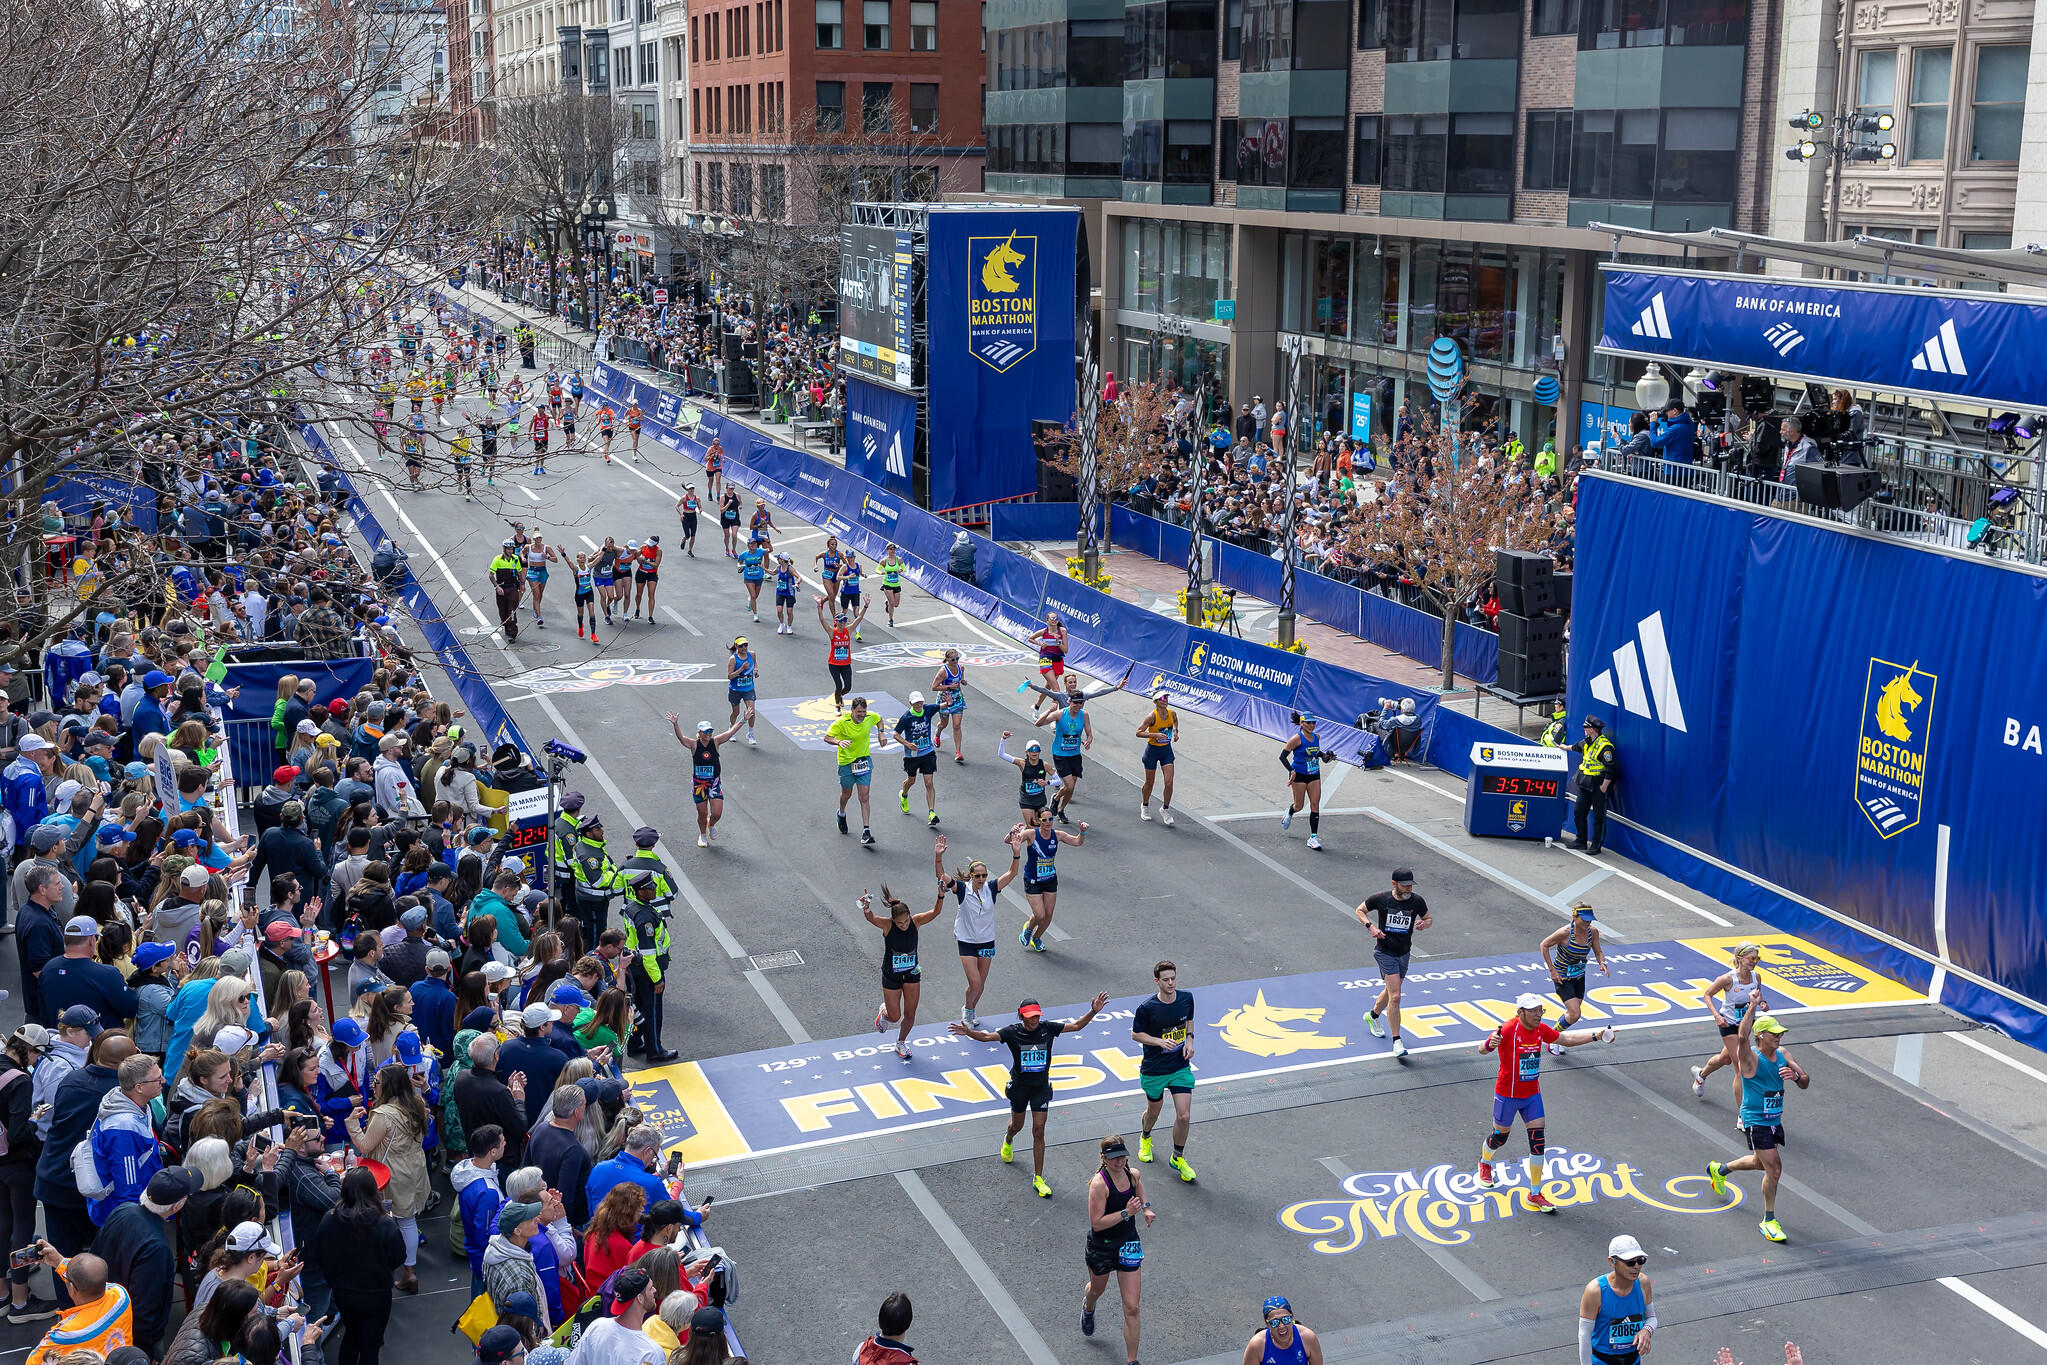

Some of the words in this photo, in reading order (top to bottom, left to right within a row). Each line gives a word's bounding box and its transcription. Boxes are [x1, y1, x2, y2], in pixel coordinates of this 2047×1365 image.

[972, 298, 1032, 313] BOSTON
[1736, 296, 1768, 310] BANK
[1769, 299, 1785, 312] OF
[1786, 301, 1840, 318] AMERICA
[972, 314, 1032, 326] MARATHON
[852, 410, 862, 424] BANK
[870, 418, 887, 432] AMERICA
[1045, 596, 1062, 610] BANK
[1067, 606, 1090, 624] AMERICA
[1208, 668, 1224, 679] BANK
[1224, 672, 1232, 681] OF
[1232, 675, 1263, 690] AMERICA
[1210, 652, 1244, 673] BOSTON
[1244, 664, 1294, 688] MARATHON
[1165, 679, 1190, 694] BOSTON
[1190, 685, 1224, 703] MARATHON
[1524, 752, 1562, 760] MARATHON
[1862, 736, 1923, 772] BOSTON
[1860, 756, 1920, 788] MARATHON
[1496, 778, 1556, 795] 3:57:44
[1860, 774, 1877, 787] BANK
[1878, 780, 1888, 790] OF
[1887, 784, 1918, 800] AMERICA
[1390, 916, 1410, 926] 16376
[1337, 978, 1387, 990] 202
[1405, 965, 1516, 983] BOSTON
[1766, 964, 1838, 973] BOSTON
[1778, 970, 1846, 978] MARATHON
[1022, 1052, 1045, 1062] 21135
[1612, 1324, 1640, 1337] 20864
